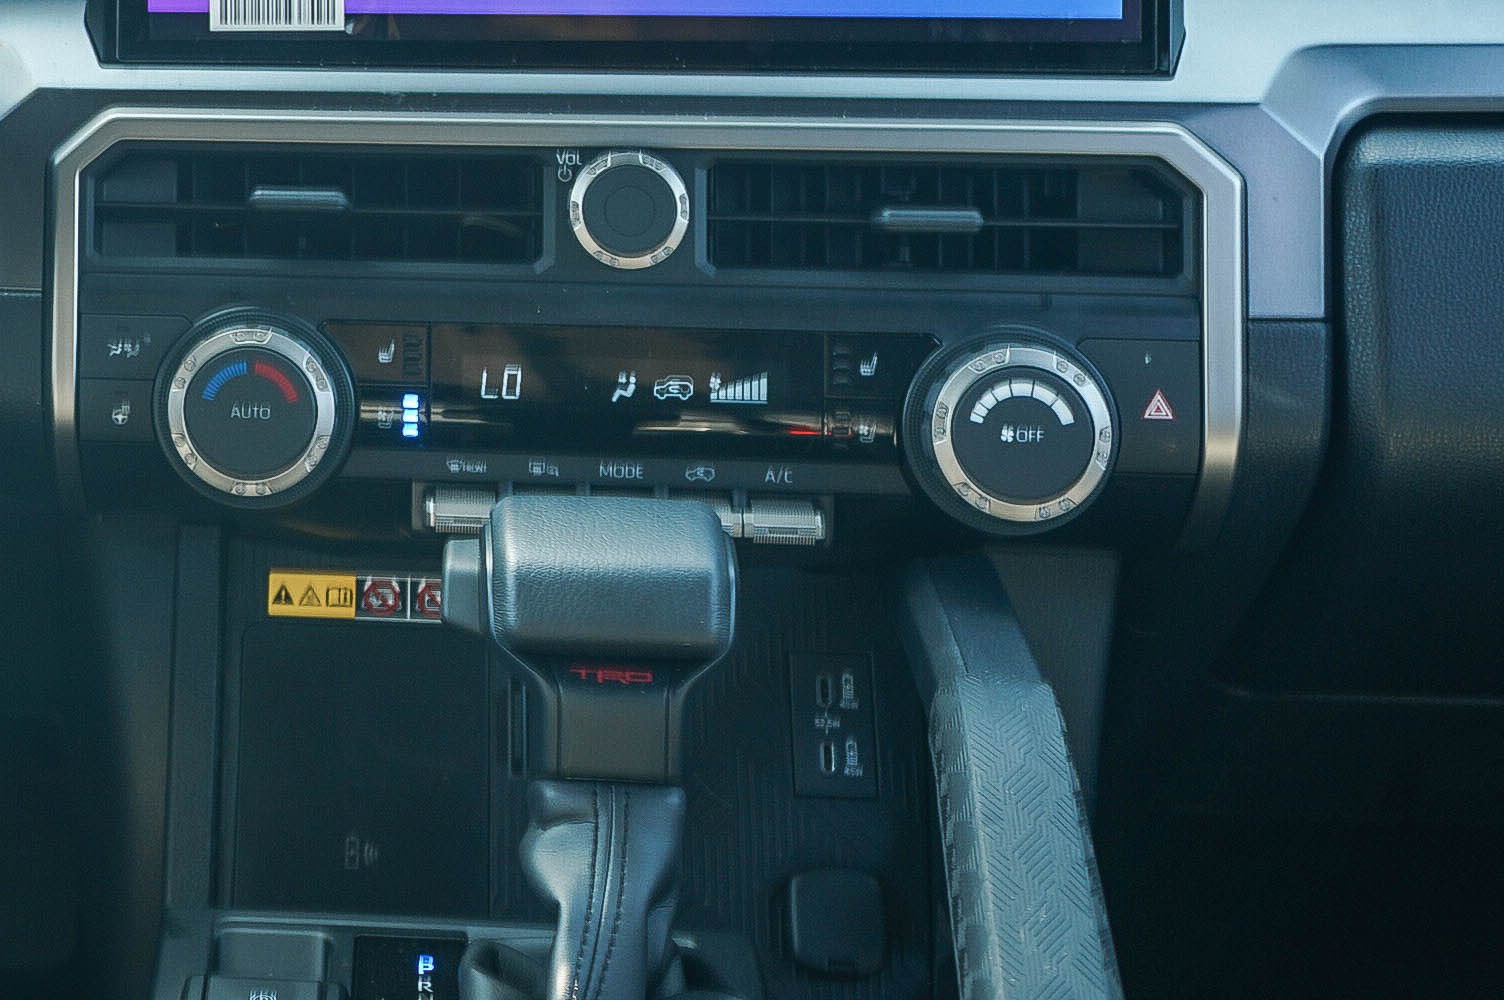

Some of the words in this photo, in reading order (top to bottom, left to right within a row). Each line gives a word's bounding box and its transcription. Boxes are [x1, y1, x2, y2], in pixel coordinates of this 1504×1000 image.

[556, 150, 583, 166] VOL
[229, 403, 271, 420] AUTO
[1015, 425, 1045, 443] OFF
[599, 461, 644, 479] MODE
[764, 466, 793, 483] A/C
[569, 665, 654, 685] TRD
[417, 977, 434, 993] R
